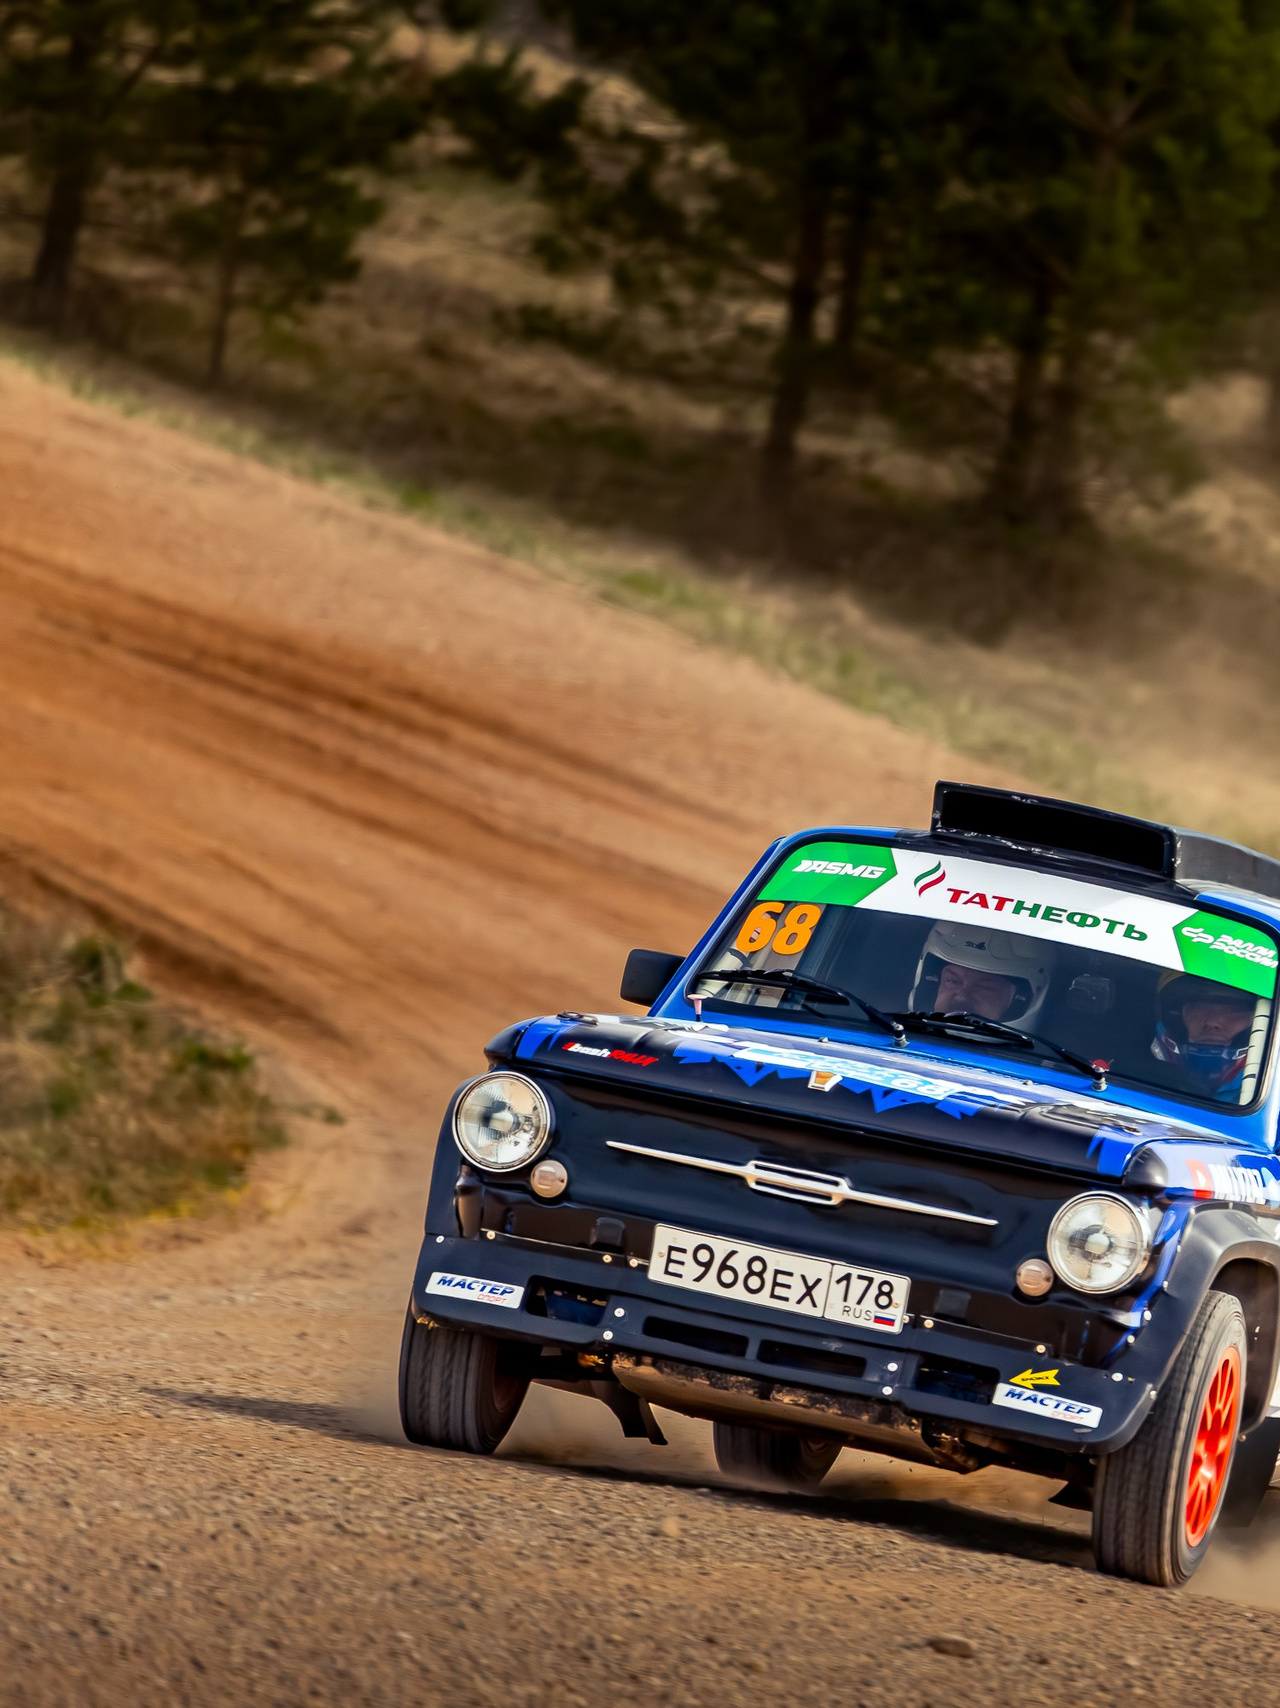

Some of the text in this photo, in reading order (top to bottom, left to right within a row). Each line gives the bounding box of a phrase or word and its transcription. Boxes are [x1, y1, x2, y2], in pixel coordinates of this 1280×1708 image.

[735, 901, 822, 955] 68
[947, 888, 1148, 941] ТАТНЕФТЬ
[437, 1275, 515, 1296] МАСТЕР
[663, 1243, 894, 1309] E968EX 178
[841, 1305, 872, 1321] RUS
[1004, 1387, 1092, 1415] МАСТЕР
